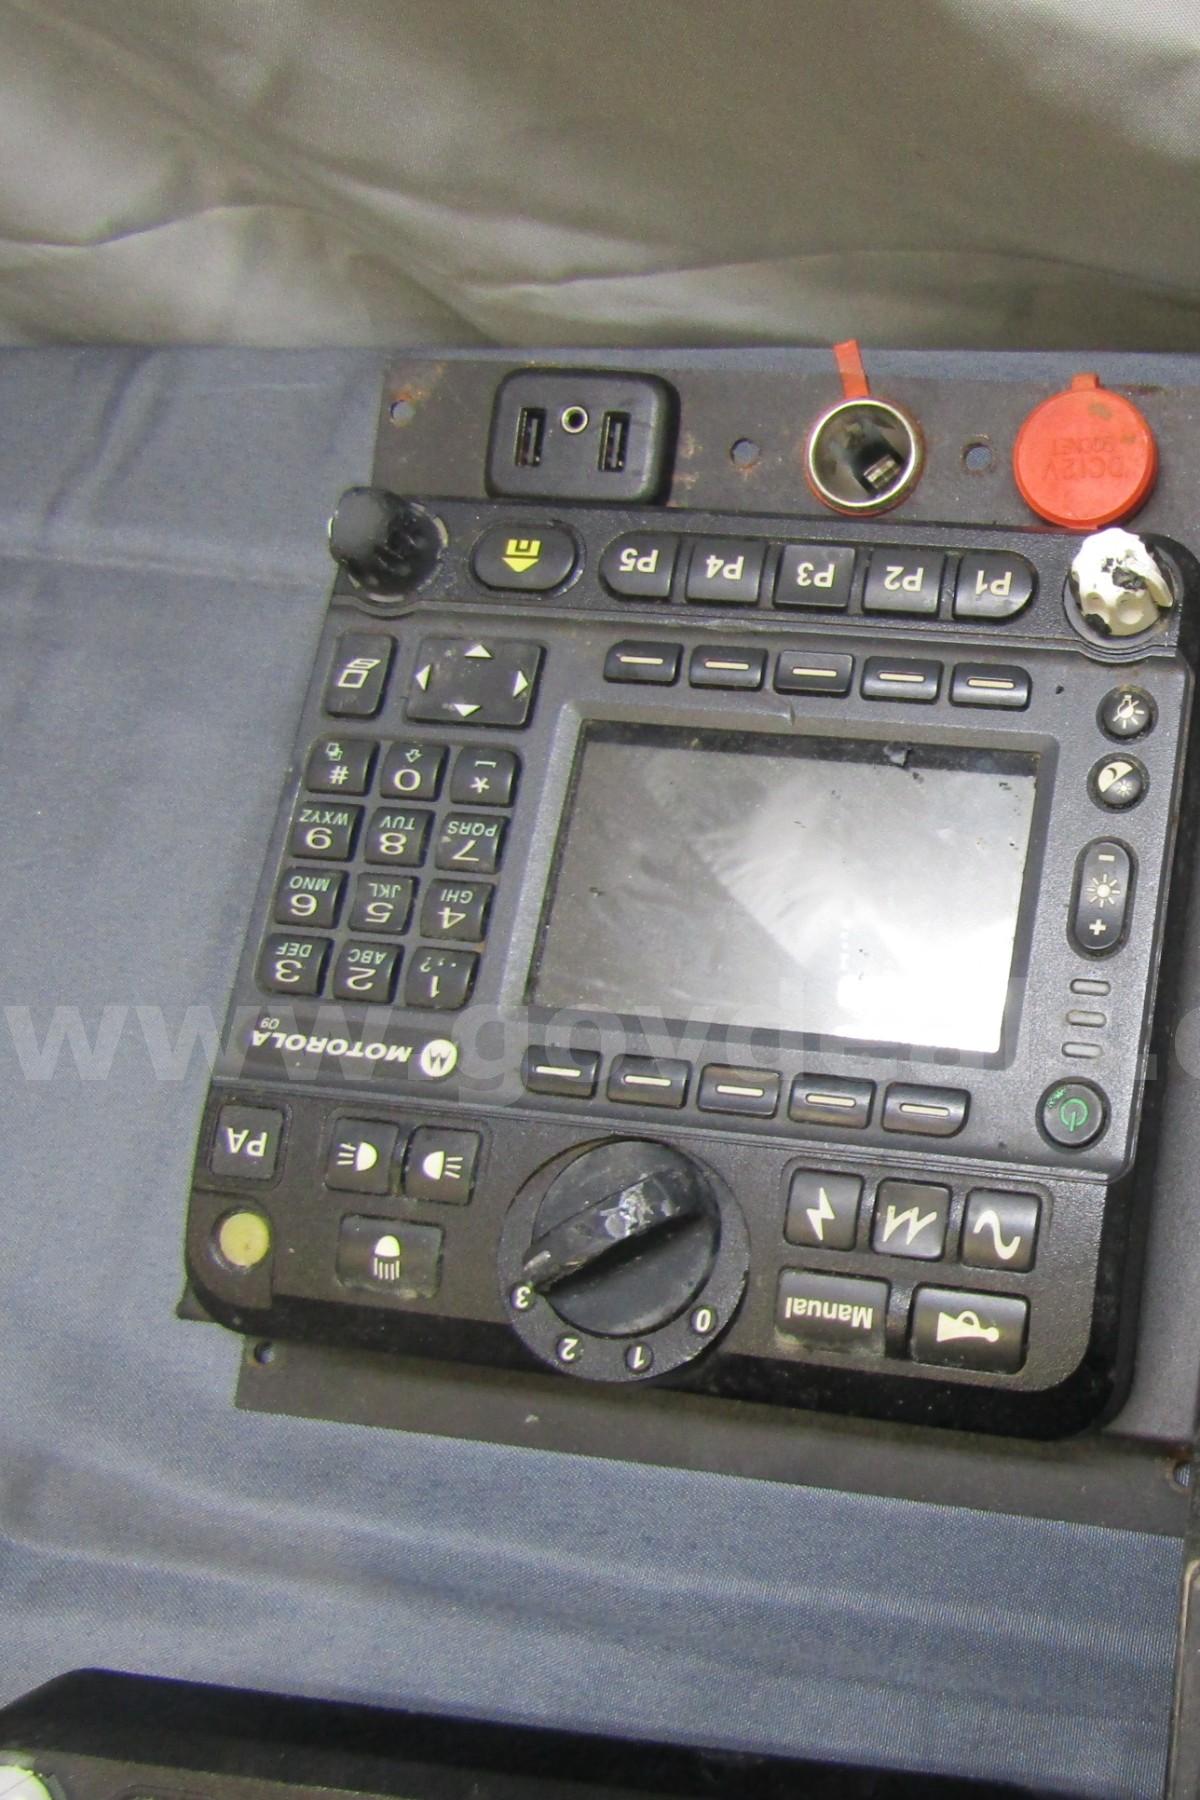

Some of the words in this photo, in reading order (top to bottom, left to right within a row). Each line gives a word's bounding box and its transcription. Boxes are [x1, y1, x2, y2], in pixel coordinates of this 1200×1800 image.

[619, 548, 658, 572] P5
[706, 555, 744, 580] P4
[797, 562, 834, 587] P3
[884, 566, 924, 592] P2
[976, 570, 1012, 596] P1
[329, 766, 348, 784] #
[299, 810, 348, 825] WXYZ
[380, 816, 414, 830] TUV
[305, 828, 332, 849] 9
[447, 821, 497, 837] PQRS
[380, 833, 406, 854] 8
[453, 840, 479, 861] 7
[290, 876, 330, 891] MNO
[369, 883, 401, 898] JKL
[291, 894, 316, 916] 6
[441, 890, 472, 903] GHI
[366, 903, 393, 922] 5
[438, 907, 465, 928] 4
[276, 943, 312, 957] DEF
[348, 949, 386, 964] ABC
[275, 960, 302, 982] 3
[346, 967, 375, 990] 2
[431, 976, 439, 997] 1
[252, 1031, 412, 1062] MOTOROLA
[227, 1128, 267, 1156] PA
[515, 1287, 530, 1308] 3
[696, 1309, 711, 1332] 0
[785, 1297, 873, 1329] Manual
[561, 1338, 578, 1360] 2
[633, 1347, 644, 1368] 1
